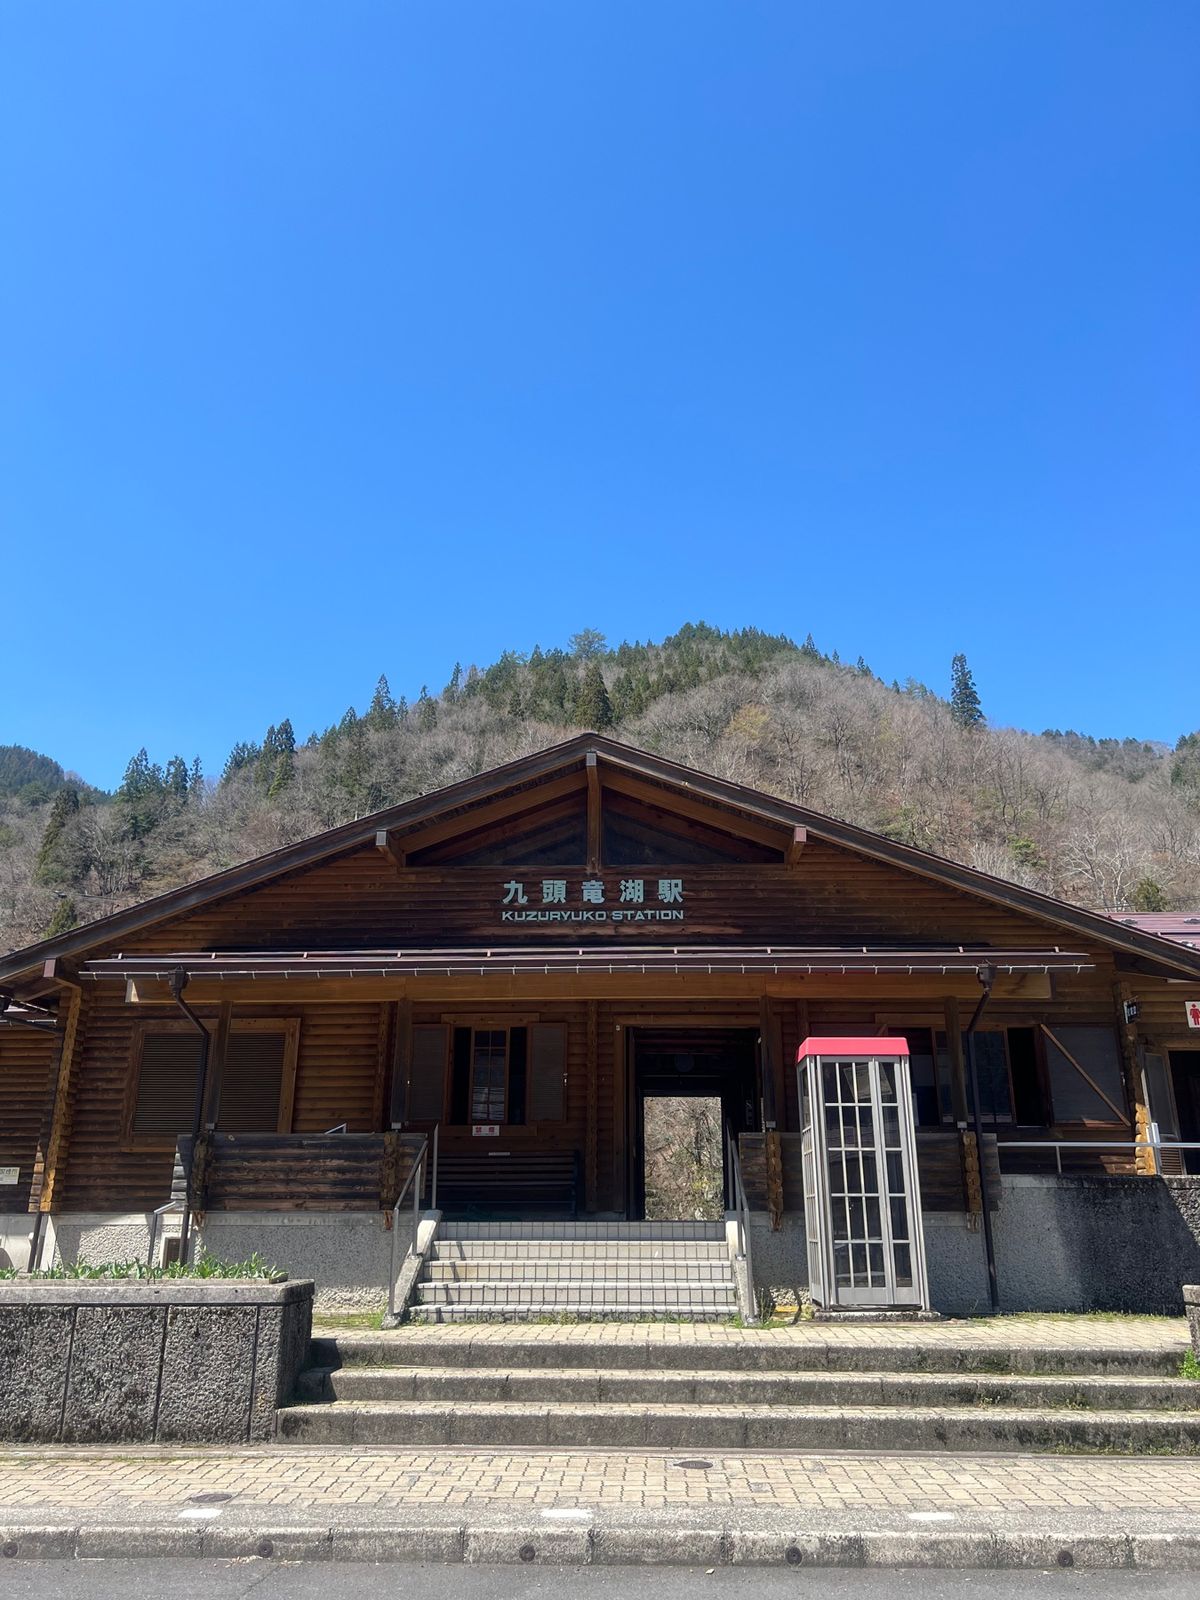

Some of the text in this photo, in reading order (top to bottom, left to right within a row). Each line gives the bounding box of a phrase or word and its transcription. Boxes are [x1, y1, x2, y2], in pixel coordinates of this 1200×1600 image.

[502, 879, 684, 904] 九頭竜湖駅
[502, 910, 684, 921] KUZURYUKO STATION
